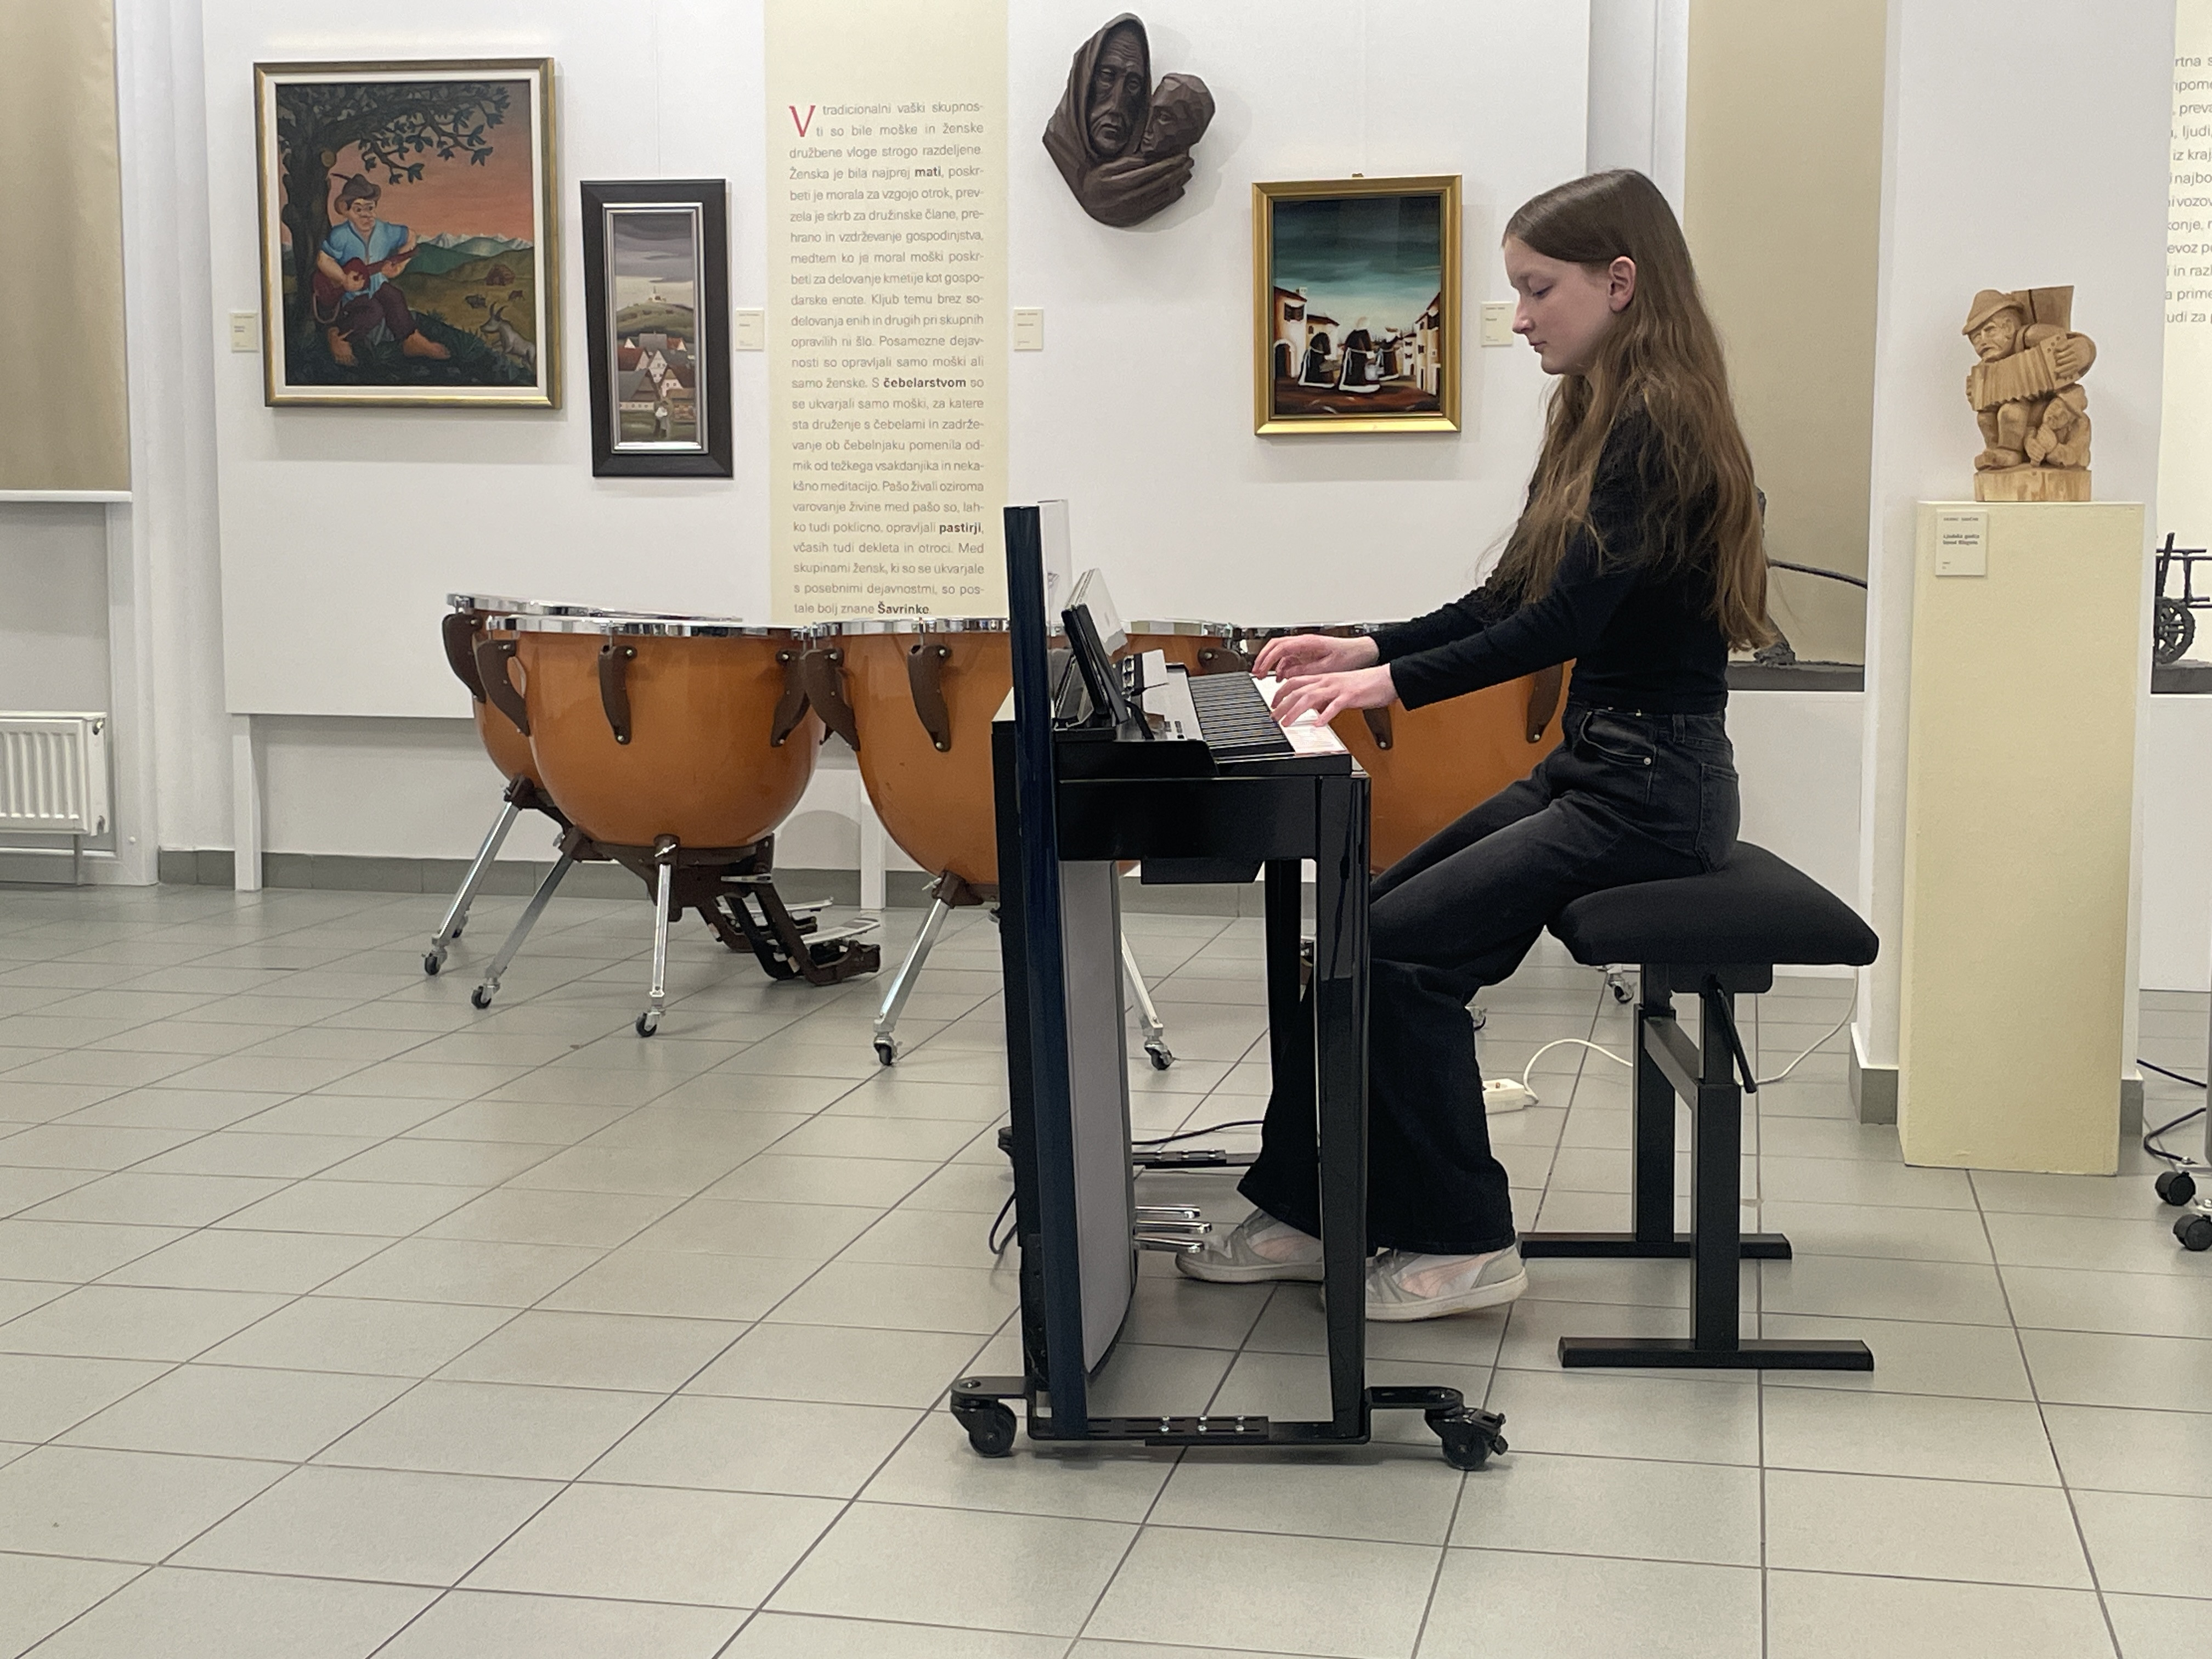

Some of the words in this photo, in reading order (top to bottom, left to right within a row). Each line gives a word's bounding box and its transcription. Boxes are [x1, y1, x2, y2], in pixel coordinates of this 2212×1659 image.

[789, 105, 816, 137] V
[823, 103, 891, 115] tradicionalni
[897, 102, 925, 114] vaški
[932, 101, 983, 115] skupnos-
[816, 127, 823, 137] ti
[831, 128, 844, 137] so
[851, 125, 872, 136] bile
[879, 123, 917, 136] moške
[925, 124, 935, 134] in
[943, 122, 983, 134] ženske
[789, 146, 842, 159] družbene
[847, 146, 877, 160] vloge
[882, 146, 918, 160] strogo
[2173, 149, 2184, 161] iz
[2188, 149, 2212, 162] kraj
[789, 166, 829, 180] Ženska
[833, 168, 843, 181] je
[848, 167, 867, 179] bila
[872, 167, 910, 180] najprej
[949, 165, 984, 179] poskr-
[790, 190, 810, 201] beti
[813, 189, 823, 202] je
[826, 189, 864, 200] morala
[867, 191, 879, 199] za
[882, 189, 918, 202] vzgojo
[956, 189, 984, 200] prev-
[790, 211, 812, 222] zela
[814, 211, 825, 224] je
[827, 210, 851, 222] skrb
[853, 212, 866, 221] za
[868, 209, 922, 221] družinske
[925, 208, 958, 221] člane,
[961, 210, 984, 221] pre-
[791, 232, 821, 243] hrano
[826, 232, 835, 242] in
[839, 230, 902, 244] vzdrževanje
[906, 230, 984, 244] gospodinjstva,
[791, 253, 836, 264] medtem
[842, 253, 854, 263] ko
[859, 253, 869, 265] je
[874, 252, 905, 263] moral
[911, 250, 944, 262] moški
[949, 250, 984, 264] poskr-
[2174, 265, 2186, 276] in
[791, 274, 811, 285] beti
[814, 276, 826, 284] za
[828, 273, 881, 286] delovanje
[883, 273, 923, 285] kmetije
[926, 272, 942, 283] kot
[945, 274, 984, 285] gospo-
[791, 295, 827, 306] darske
[871, 294, 899, 307] Kljub
[904, 294, 932, 305] temu
[938, 294, 961, 304] brez
[966, 295, 984, 303] so-
[791, 315, 844, 329] delovanja
[846, 315, 870, 326] enih
[873, 317, 882, 325] in
[884, 314, 921, 328] drugih
[923, 315, 937, 327] pri
[939, 314, 984, 326] skupnih
[2191, 313, 2206, 322] za
[791, 336, 837, 349] opravilih
[879, 335, 945, 346] Posamezne
[950, 335, 984, 348] dejav-
[792, 358, 819, 368] nosti
[842, 357, 891, 370] opravljali
[896, 359, 928, 367] samo
[933, 356, 966, 367] moški
[970, 356, 984, 366] ali
[826, 377, 867, 388] ženske.
[872, 377, 879, 388] S
[883, 376, 966, 388] čebelarstvom
[970, 379, 984, 388] so
[792, 400, 805, 409] se
[809, 398, 854, 411] ukvarjali
[858, 400, 889, 409] samo
[893, 398, 929, 409] moški,
[933, 400, 945, 409] za
[950, 398, 984, 408] katere
[792, 421, 809, 430] sta
[812, 419, 861, 432] druženje
[864, 421, 870, 430] s
[873, 419, 925, 430] čebelami
[929, 419, 939, 429] in
[942, 419, 984, 430] zadrže-
[792, 442, 822, 453] vanje
[826, 440, 840, 450] ob
[844, 439, 905, 453] čebelnjaku
[909, 439, 961, 452] pomenila
[966, 439, 984, 450] od-
[793, 460, 812, 471] mik
[814, 461, 828, 471] od
[831, 460, 873, 473] težkega
[875, 460, 939, 473] vsakdanjika
[941, 461, 951, 470] in
[953, 461, 984, 471] neka-
[793, 481, 819, 491] kšno
[883, 481, 909, 492] Pašo
[911, 481, 938, 492] živali
[940, 481, 984, 492] oziroma
[793, 504, 846, 514] varovanje
[849, 501, 881, 512] živine
[884, 501, 909, 512] med
[913, 501, 940, 514] pašo
[963, 501, 984, 512] lah-
[793, 522, 806, 532] ko
[809, 522, 830, 532] tudi
[886, 522, 935, 535] opravljali
[793, 542, 828, 552] včasih
[833, 542, 854, 552] tudi
[859, 542, 899, 553] dekleta
[904, 543, 914, 552] in
[958, 543, 984, 554] Med
[794, 562, 850, 574] skupinami
[853, 562, 888, 574] žensk,
[890, 563, 899, 573] ki
[902, 565, 916, 573] so
[934, 563, 984, 577] ukvarjale
[794, 585, 800, 593] s
[804, 583, 862, 595] posebnimi
[942, 586, 955, 594] so
[960, 586, 984, 596] pos-
[794, 603, 814, 613] tale
[817, 603, 838, 616] bolj
[841, 605, 874, 614] znane
